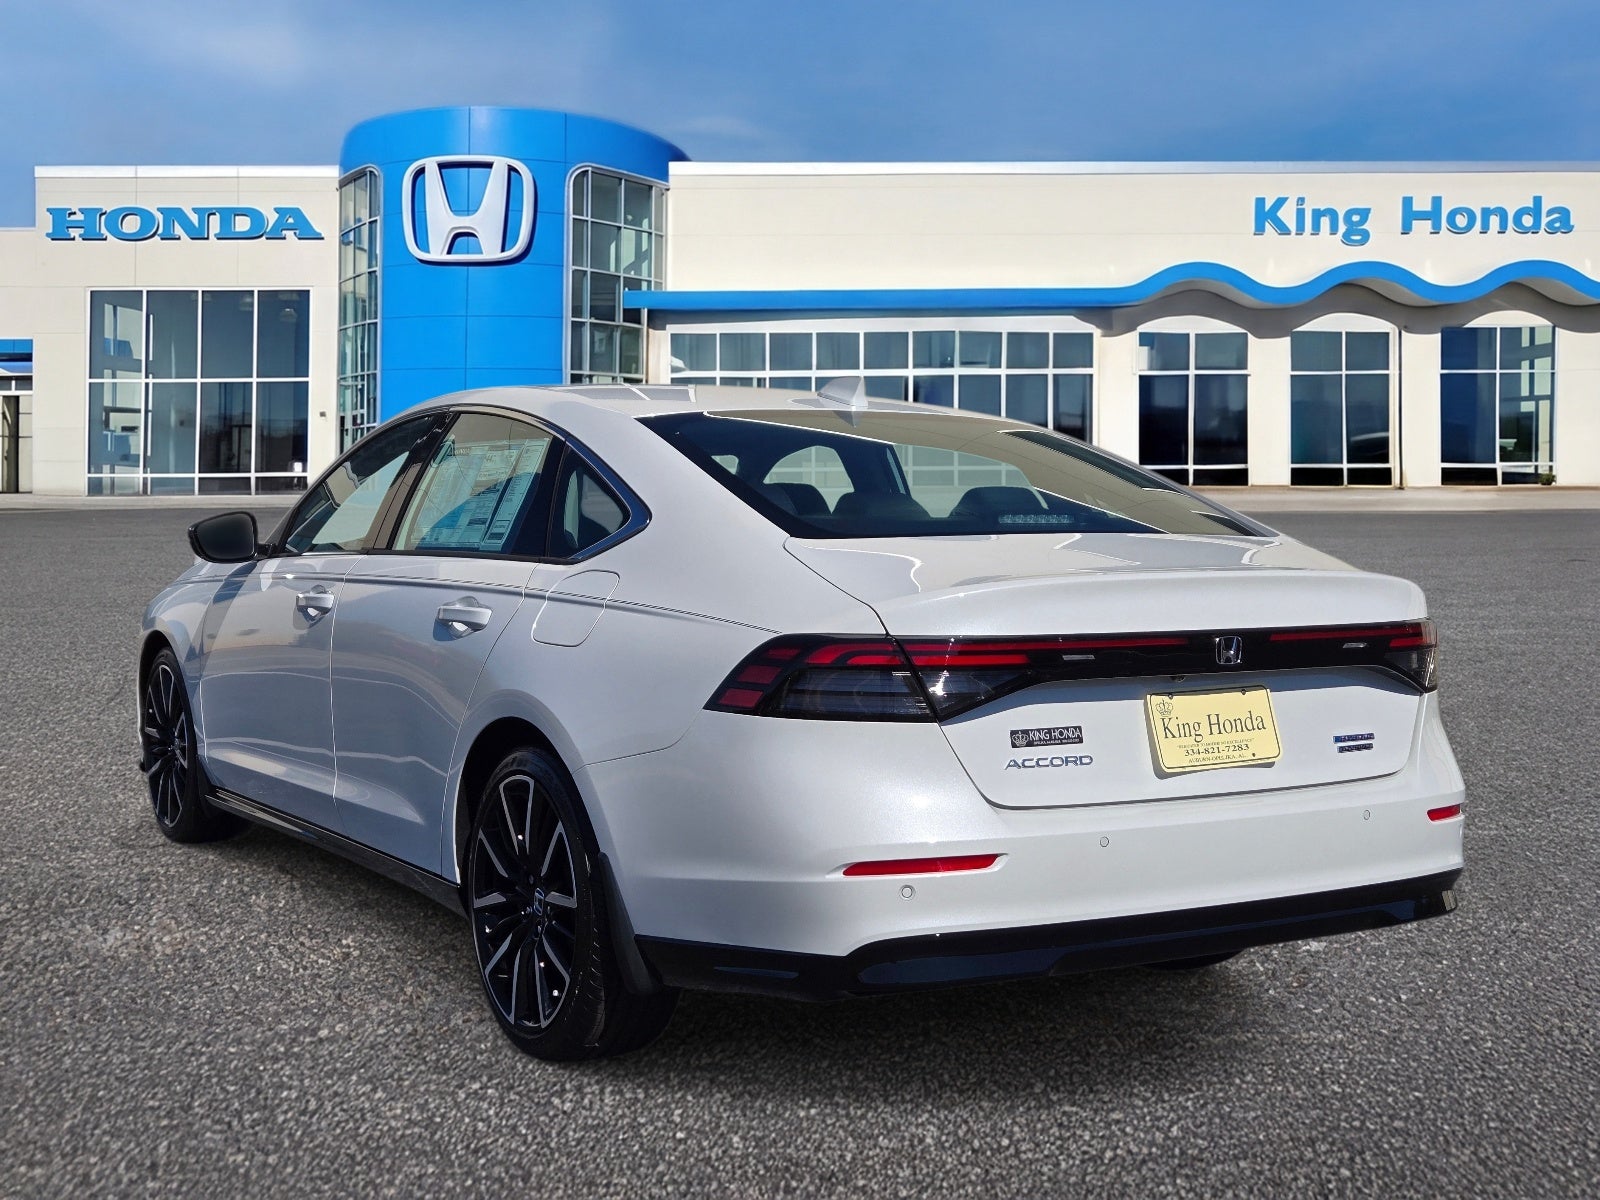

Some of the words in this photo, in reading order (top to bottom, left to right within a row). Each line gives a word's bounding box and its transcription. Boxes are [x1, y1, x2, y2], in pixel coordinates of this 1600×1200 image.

[46, 206, 324, 241] HONDA
[1253, 196, 1372, 246] King
[1400, 195, 1575, 234] Honda
[1029, 729, 1050, 741] KING
[1051, 727, 1082, 740] HONDA
[1160, 716, 1204, 743] King
[1206, 710, 1267, 735] Honda
[1184, 743, 1250, 757] 334-821-7283
[1005, 755, 1094, 770] ACCORD
